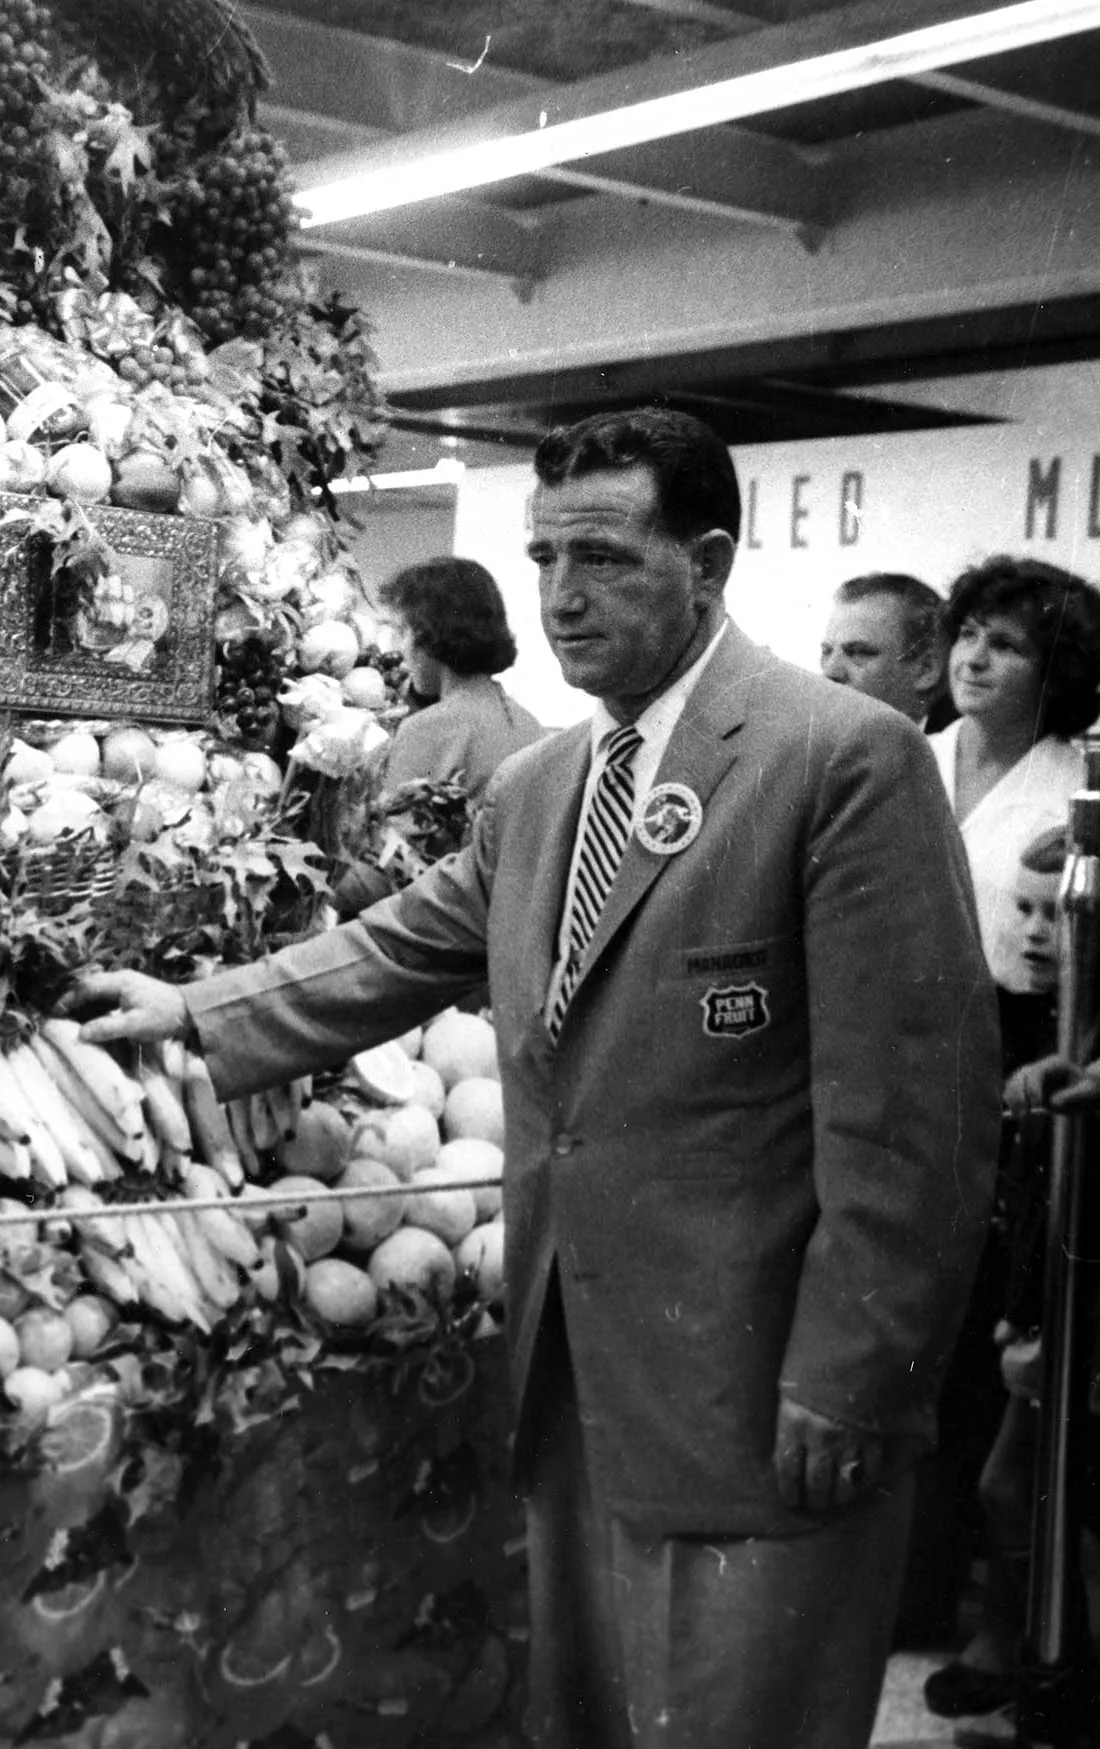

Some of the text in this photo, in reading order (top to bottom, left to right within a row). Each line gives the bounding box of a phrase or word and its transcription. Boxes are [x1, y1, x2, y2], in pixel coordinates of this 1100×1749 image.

[747, 469, 863, 549] LED
[715, 993, 754, 1013] PENN
[714, 1007, 755, 1026] FRUIT
